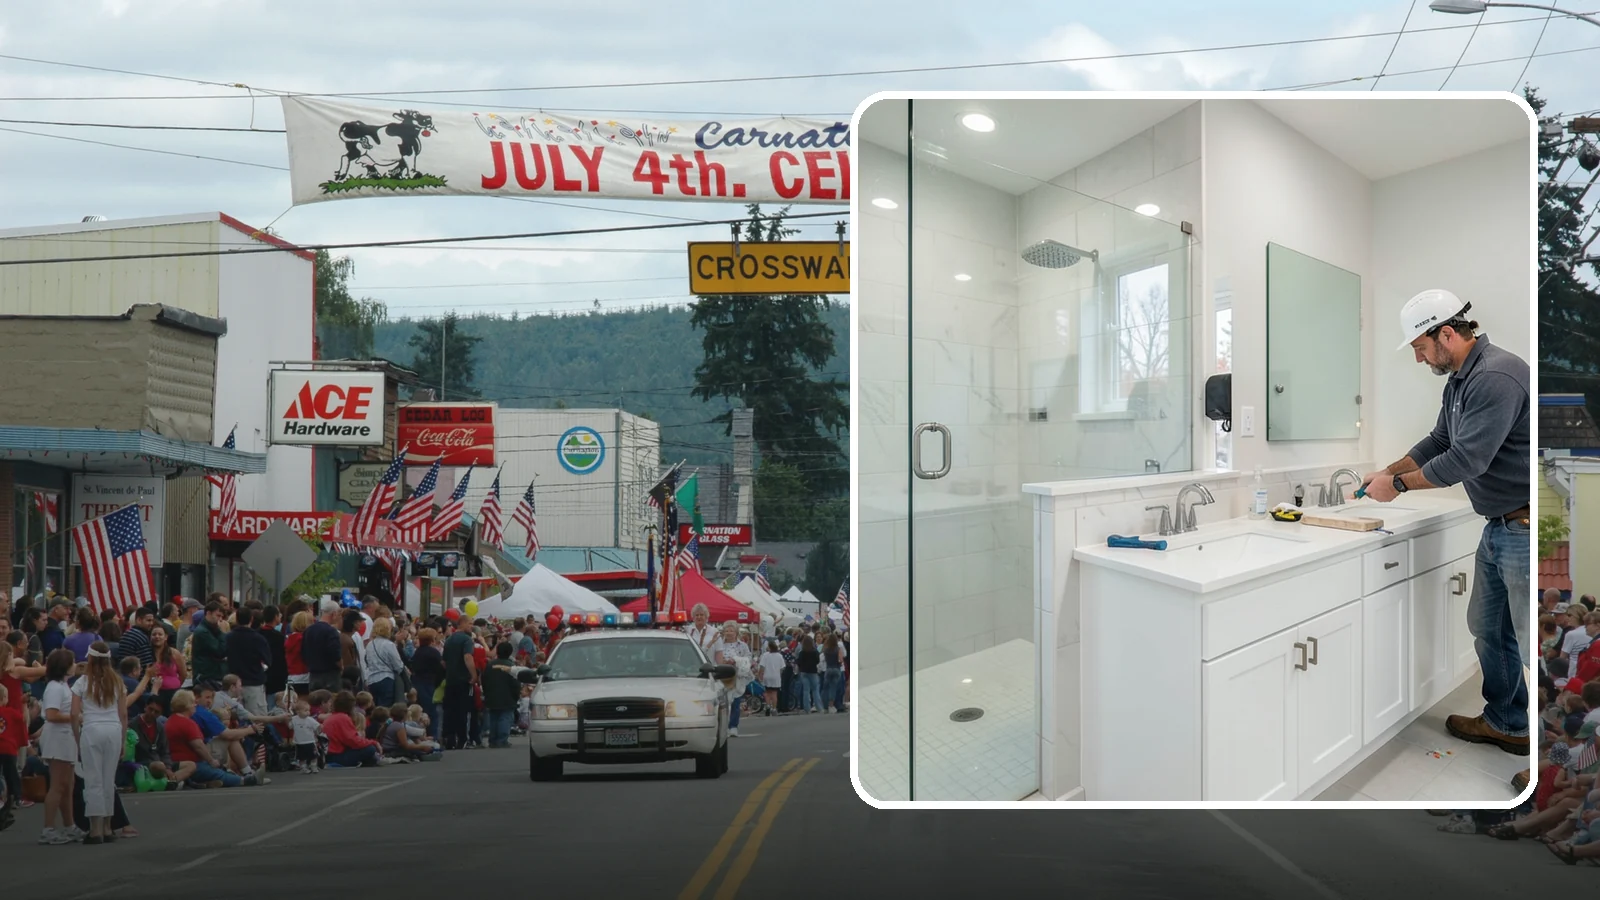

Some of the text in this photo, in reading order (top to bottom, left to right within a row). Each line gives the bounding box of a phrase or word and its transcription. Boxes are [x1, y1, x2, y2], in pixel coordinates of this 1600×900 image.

[481, 141, 604, 192] JULY
[632, 150, 746, 198] 4th.
[697, 254, 850, 280] CROSSWA
[283, 380, 373, 419] ACE
[406, 409, 452, 422] CEDAR
[283, 421, 371, 437] Hardware
[416, 428, 477, 447] Coca-Cola
[83, 485, 155, 495] St. Vincent de Paul
[688, 526, 741, 535] CRNATION
[699, 535, 730, 543] GLASS
